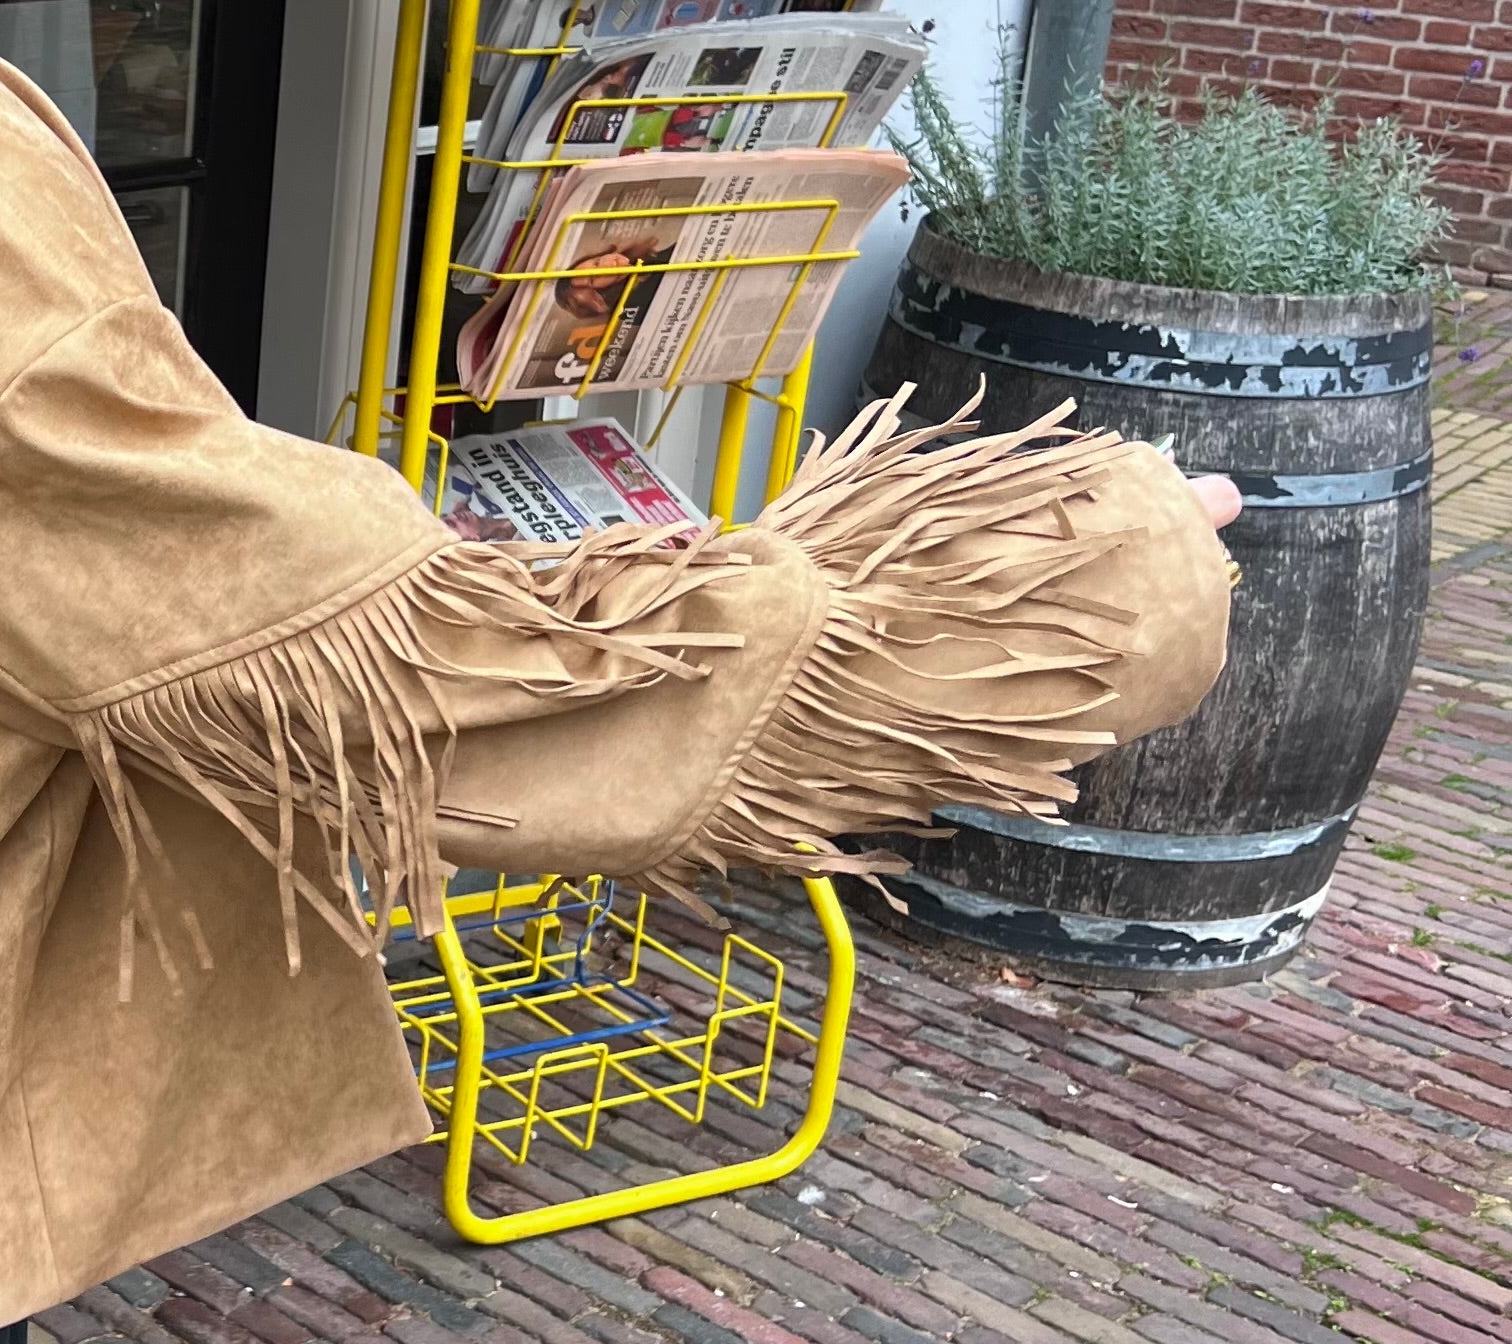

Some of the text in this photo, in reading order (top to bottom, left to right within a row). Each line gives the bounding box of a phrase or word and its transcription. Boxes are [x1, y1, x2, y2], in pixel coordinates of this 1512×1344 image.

[554, 324, 602, 384] fd
[597, 305, 640, 378] weekend
[466, 448, 493, 467] in
